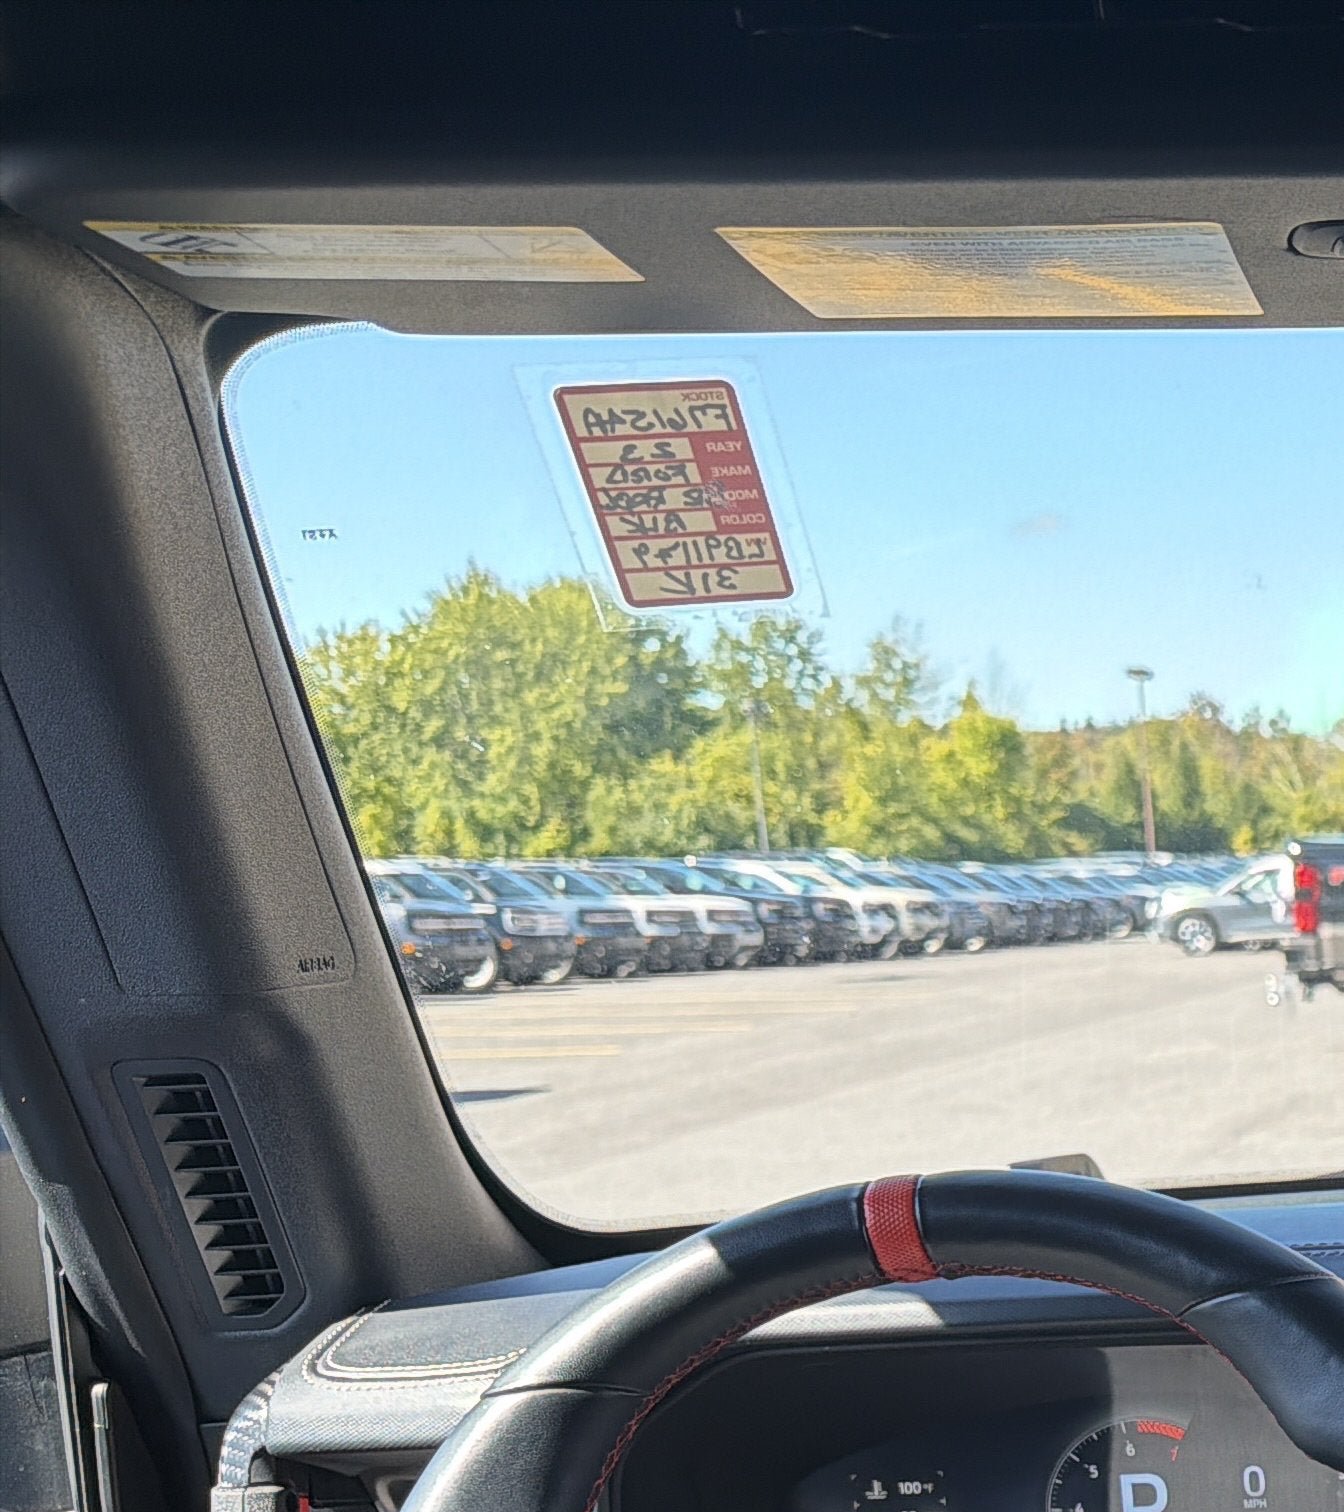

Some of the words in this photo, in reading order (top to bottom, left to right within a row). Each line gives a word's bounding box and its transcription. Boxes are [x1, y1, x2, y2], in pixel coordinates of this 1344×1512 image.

[1126, 1444, 1136, 1457] 6
[1087, 1465, 1099, 1479] 5
[1242, 1464, 1266, 1497] 0
[1243, 1498, 1268, 1509] MPH
